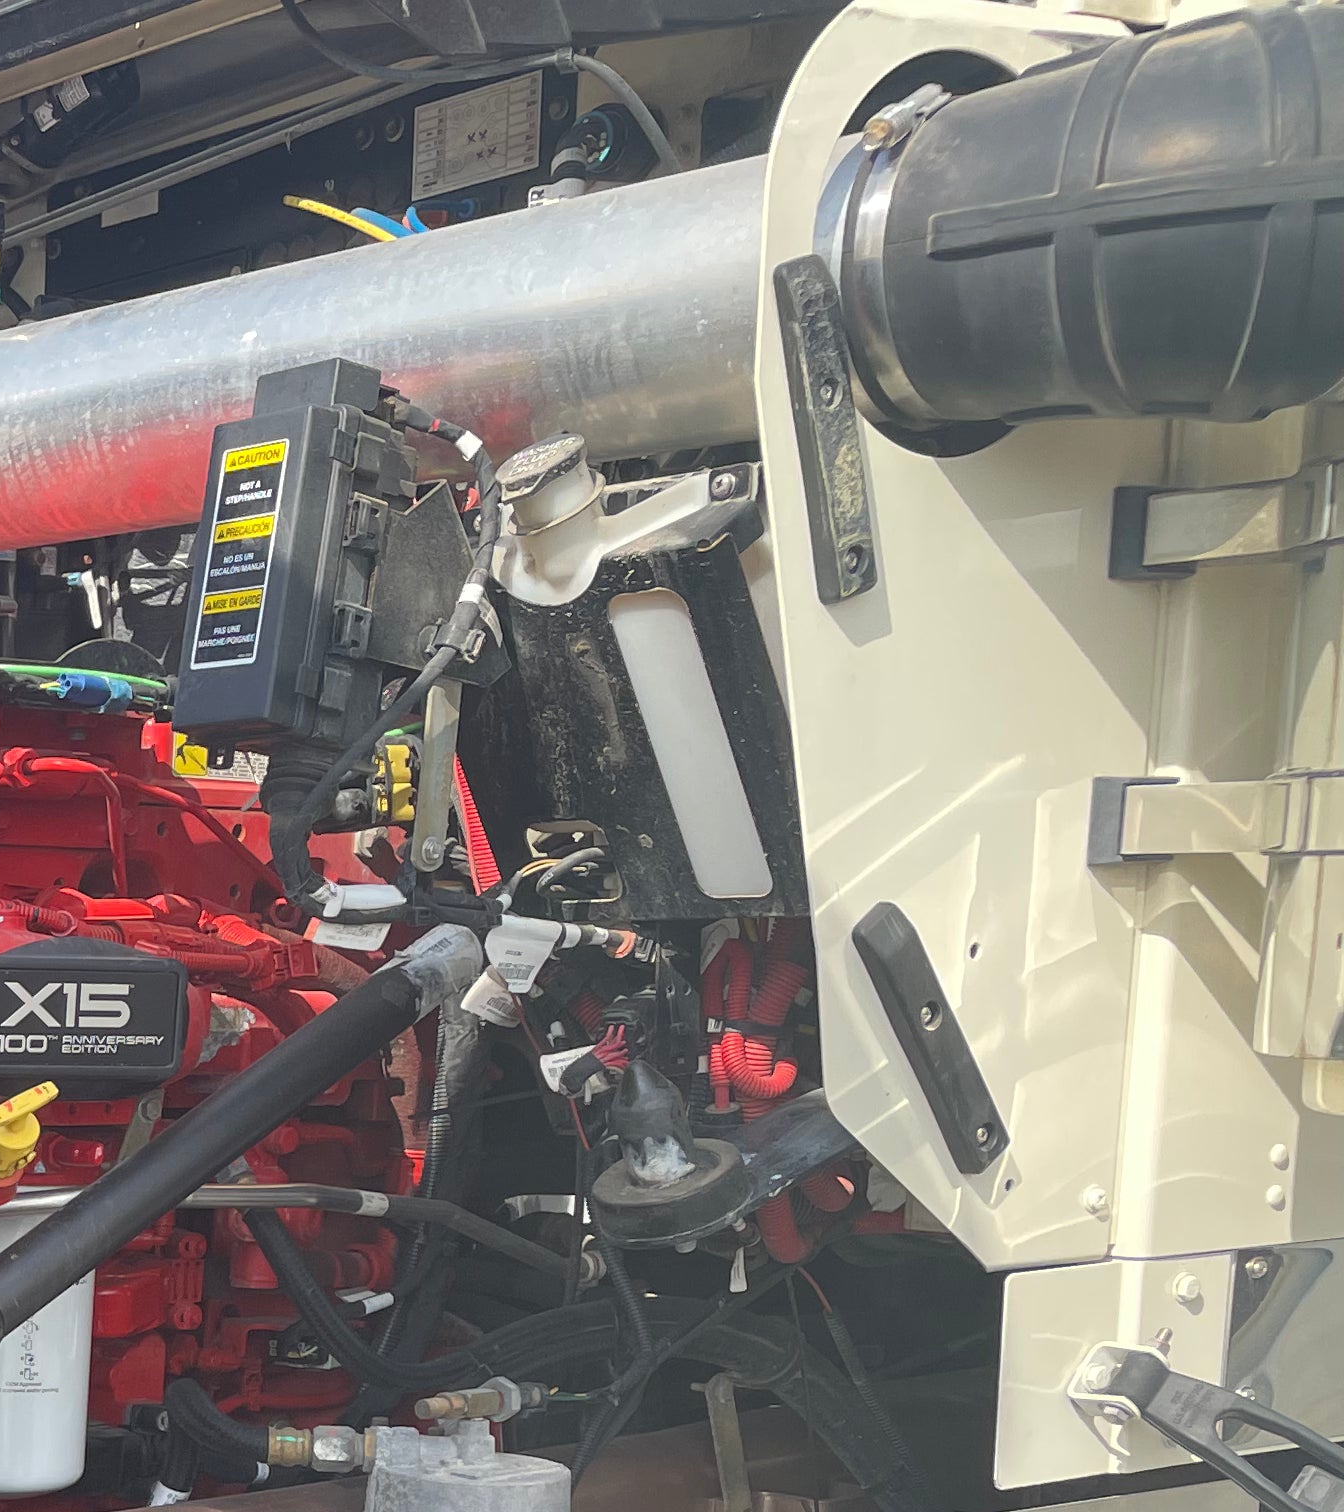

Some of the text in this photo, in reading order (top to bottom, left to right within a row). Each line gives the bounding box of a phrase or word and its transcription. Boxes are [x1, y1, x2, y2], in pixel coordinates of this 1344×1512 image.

[238, 448, 280, 465] CAUTION
[239, 480, 261, 491] NOT A
[226, 520, 270, 537] PRECAUCIÓN
[224, 556, 233, 564] NO
[235, 554, 243, 562] ES
[213, 594, 261, 609] MISE EN GARDE
[213, 626, 226, 635] PAS
[0, 981, 131, 1028] X15
[62, 1035, 164, 1045] ANNIVERSARY
[62, 1044, 118, 1054] EDITION
